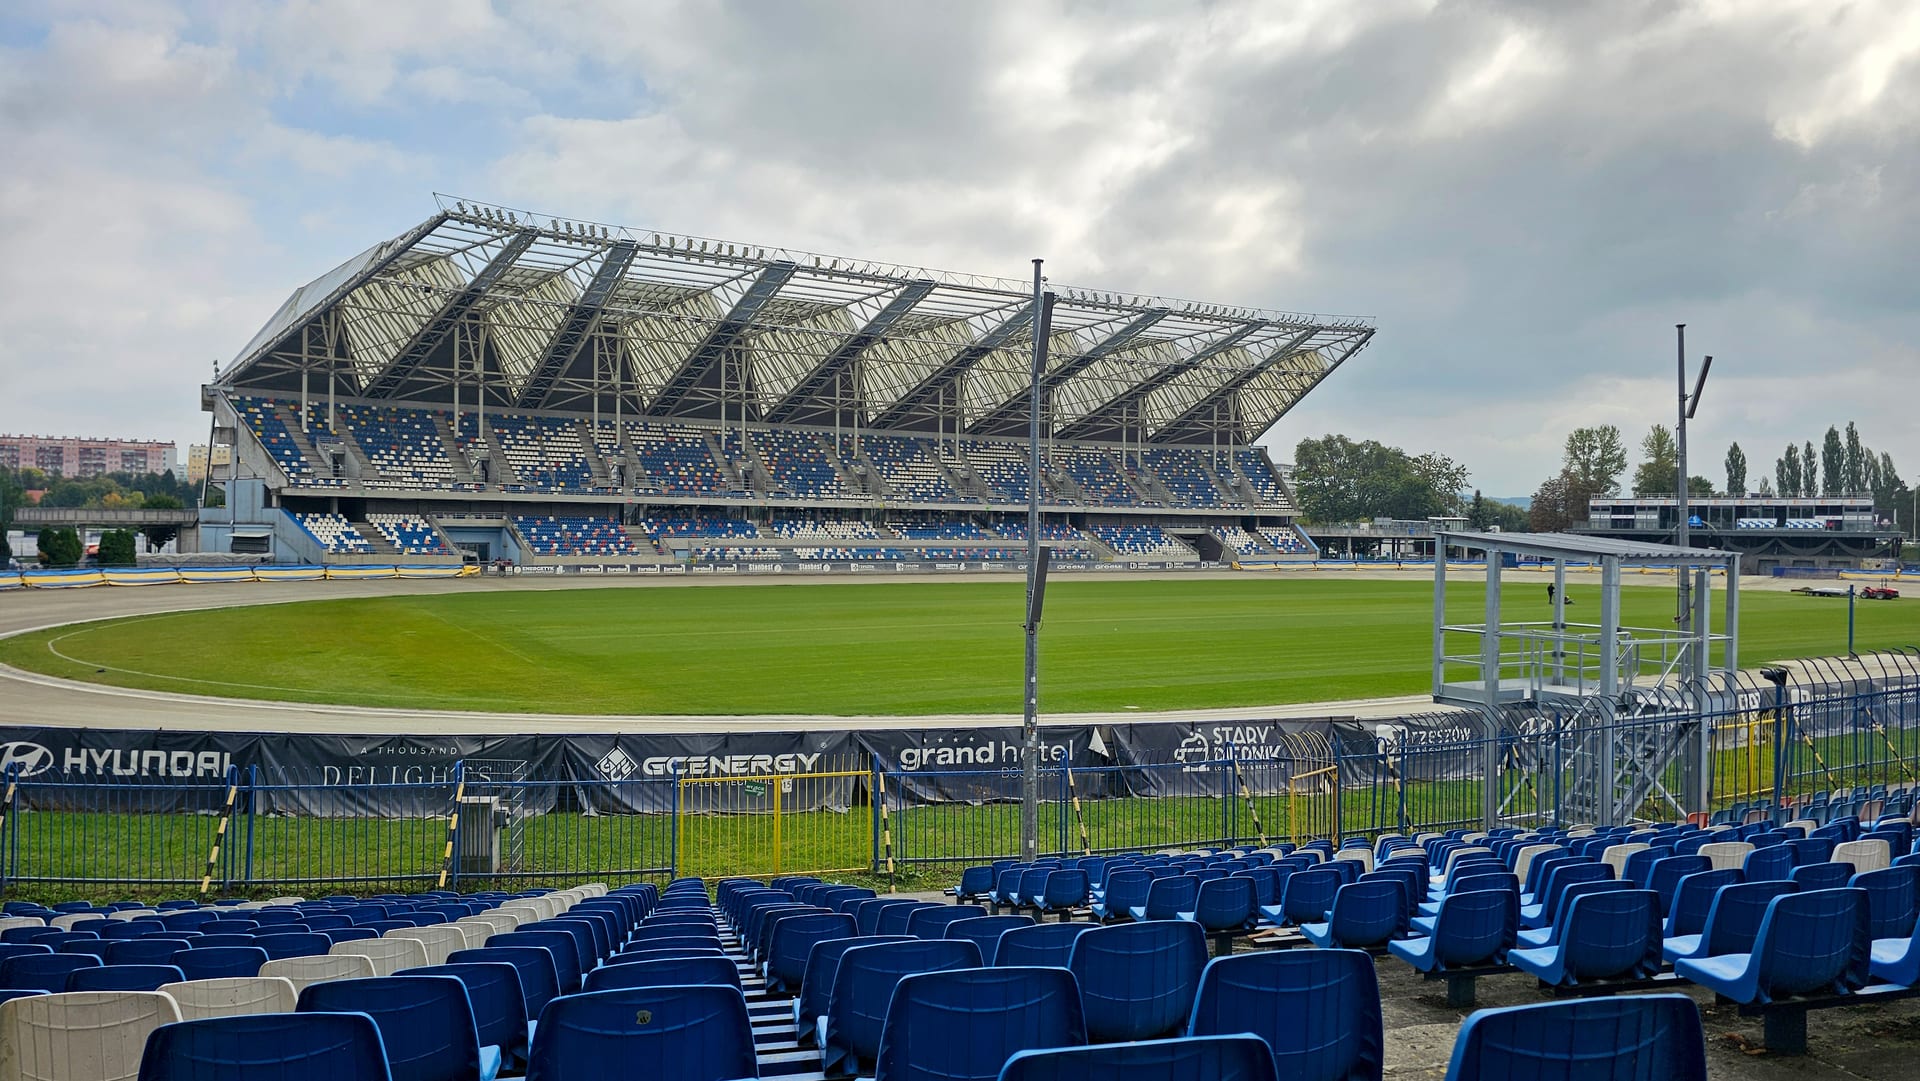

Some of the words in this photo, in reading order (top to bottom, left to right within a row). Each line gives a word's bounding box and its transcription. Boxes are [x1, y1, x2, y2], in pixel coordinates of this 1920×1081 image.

[361, 747, 369, 755] A
[378, 746, 458, 756] THOUSAND
[900, 741, 995, 771] grand
[63, 748, 232, 778] HYUNDAI
[783, 780, 792, 789] 15
